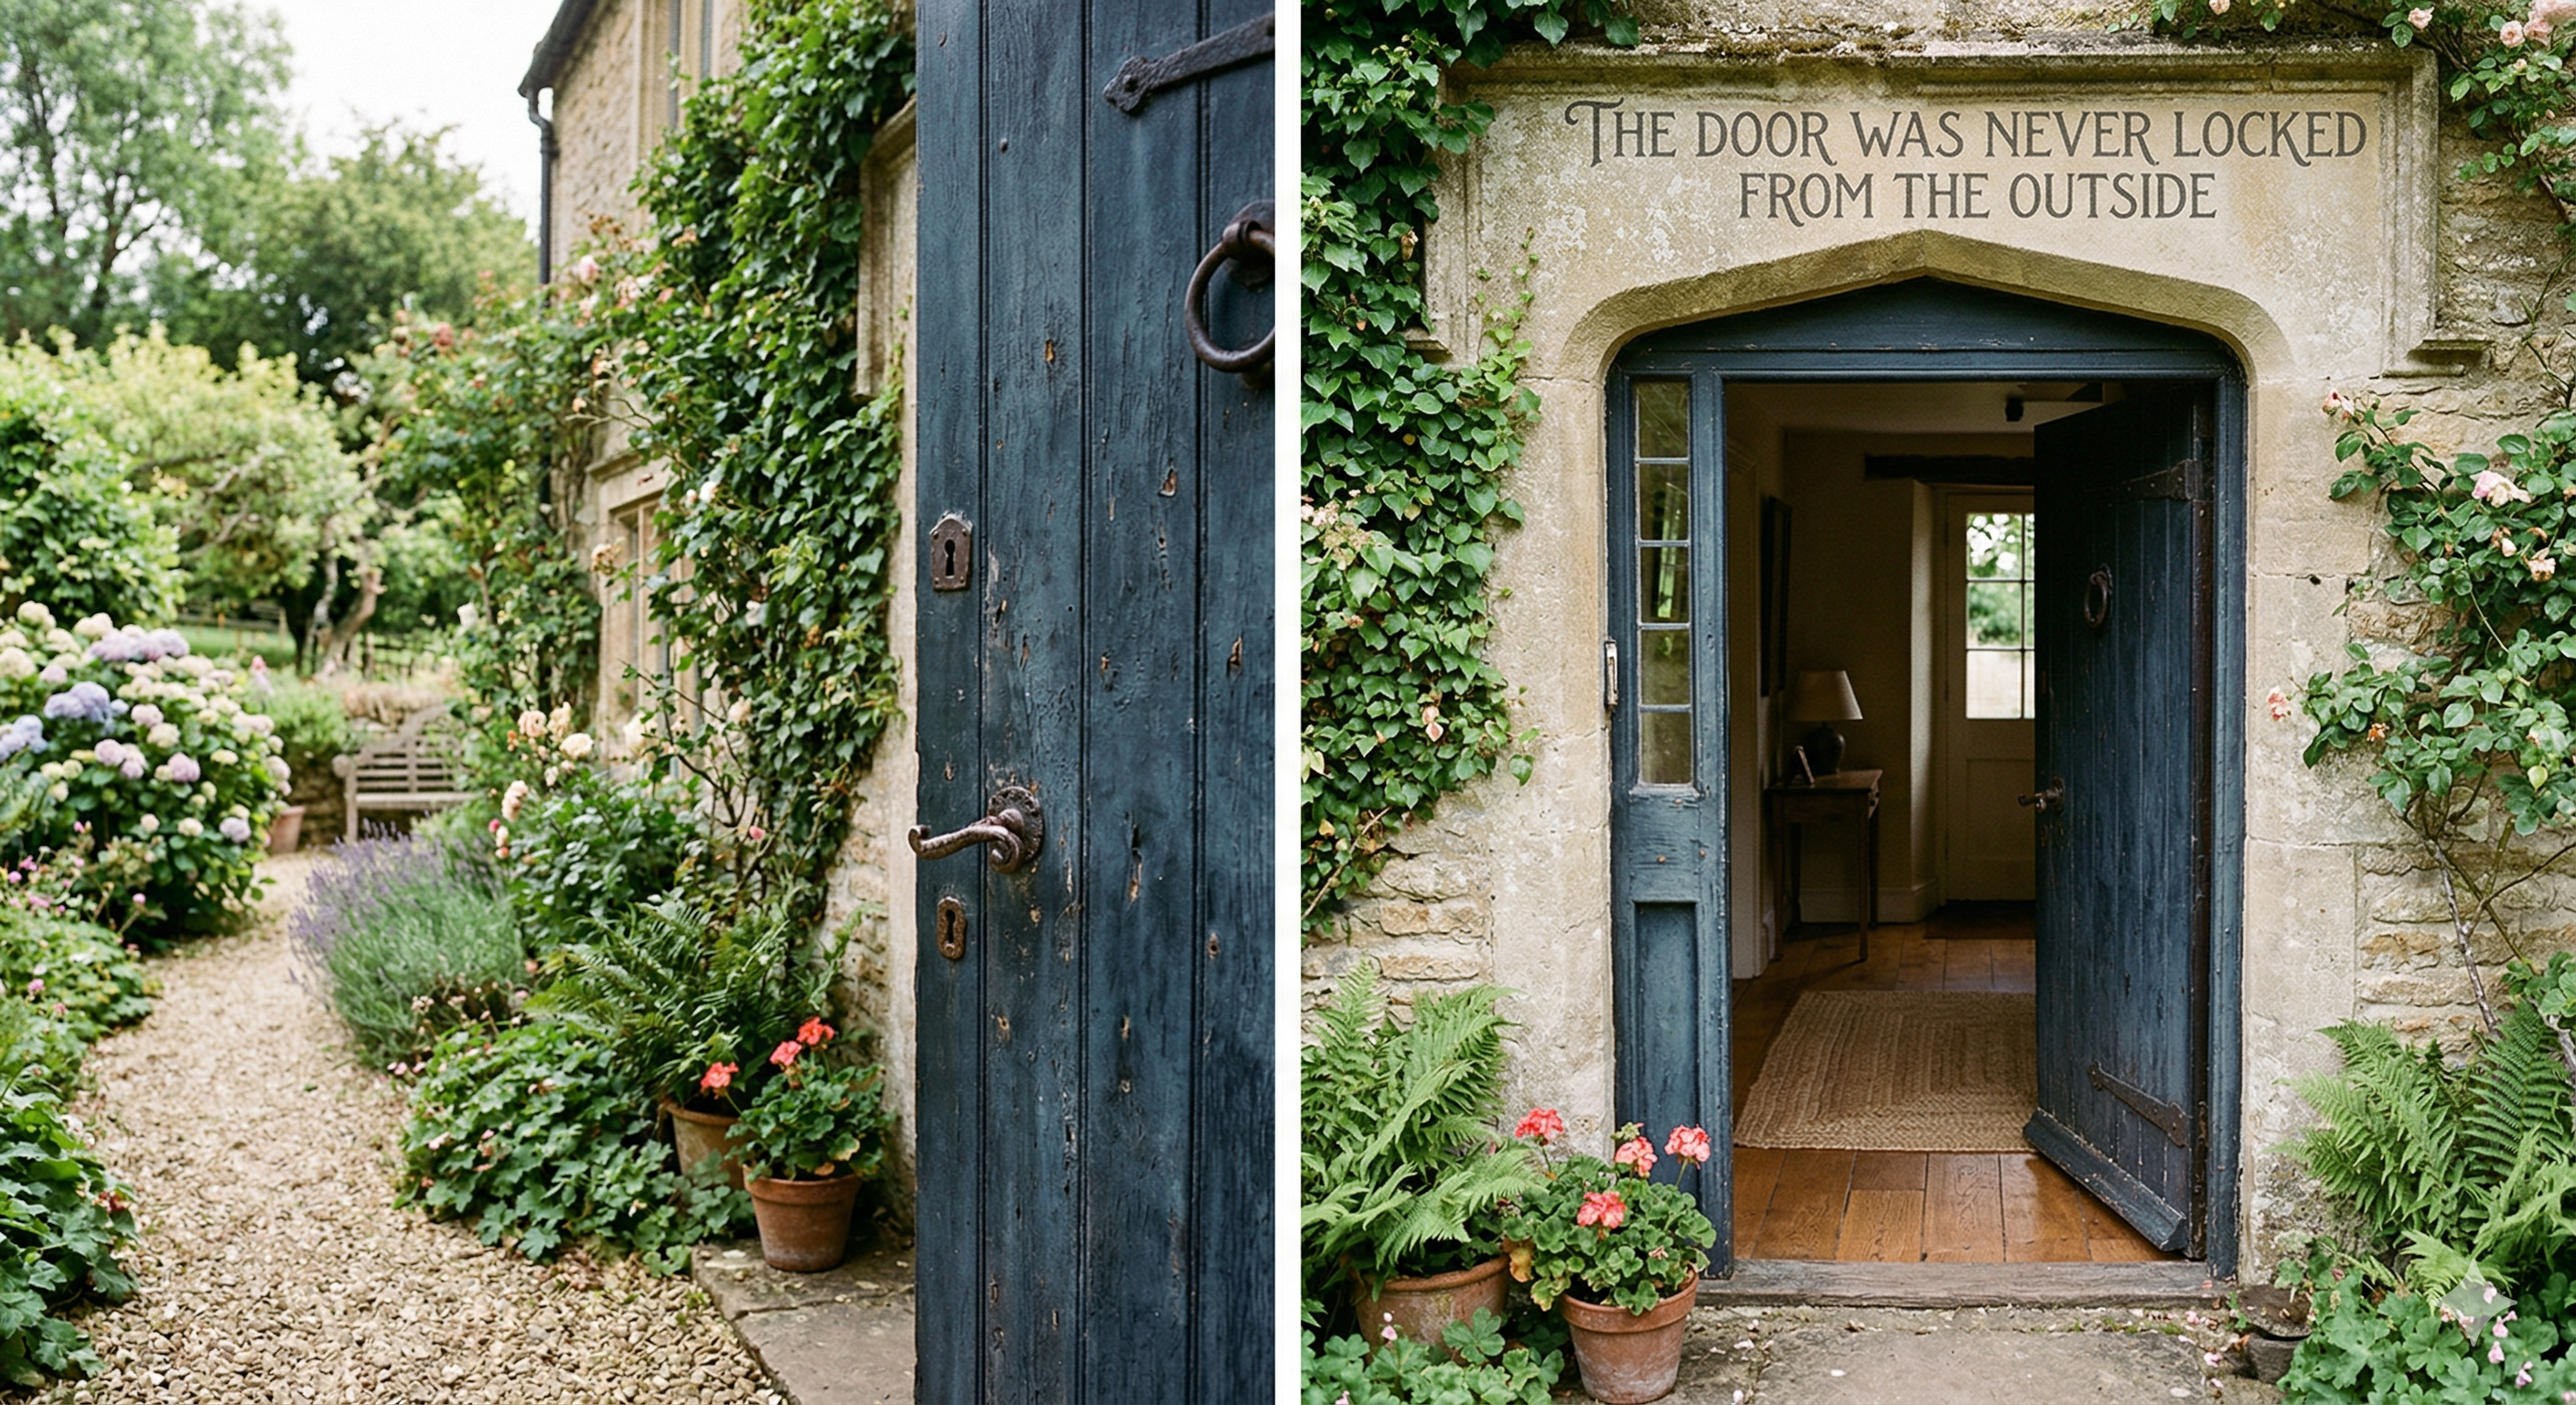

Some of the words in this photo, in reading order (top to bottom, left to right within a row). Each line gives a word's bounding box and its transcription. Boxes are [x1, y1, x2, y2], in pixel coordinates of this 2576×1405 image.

[1564, 97, 1677, 167] THE
[1695, 111, 1837, 166] DOOR
[1850, 111, 1964, 158] WAS
[1984, 111, 2160, 166] NEVER
[2174, 111, 2367, 167] LOCKED
[1739, 172, 1874, 228] FROM
[1893, 172, 1991, 219] THE
[2009, 172, 2217, 220] OUTSIDE
